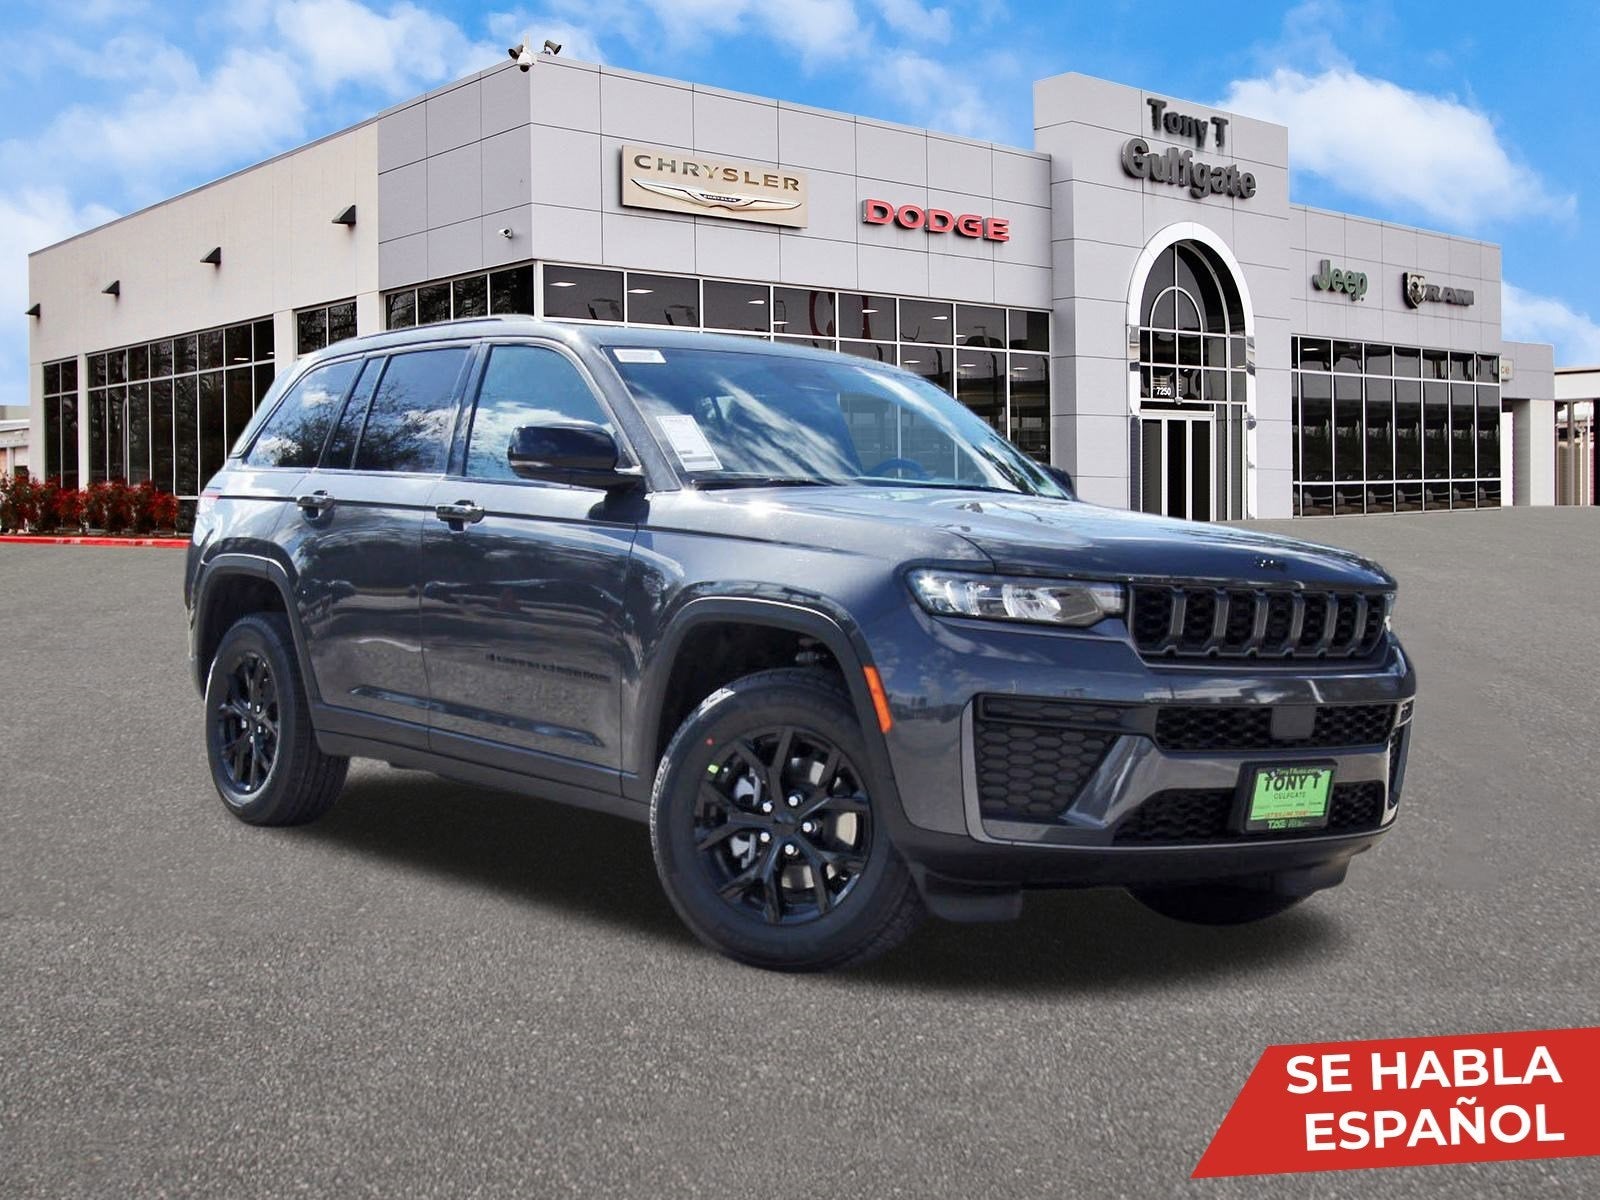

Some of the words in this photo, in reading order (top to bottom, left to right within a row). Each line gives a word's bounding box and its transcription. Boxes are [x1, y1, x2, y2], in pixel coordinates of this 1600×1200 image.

[1147, 98, 1208, 147] Tony
[1210, 116, 1229, 147] T
[633, 153, 801, 192] CHRYSLER
[1121, 138, 1257, 199] Gulfgate
[862, 198, 1011, 242] DODGE
[1312, 259, 1368, 301] Jeep
[1424, 283, 1475, 306] RAM
[1264, 773, 1308, 792] TONY
[1313, 772, 1322, 789] T
